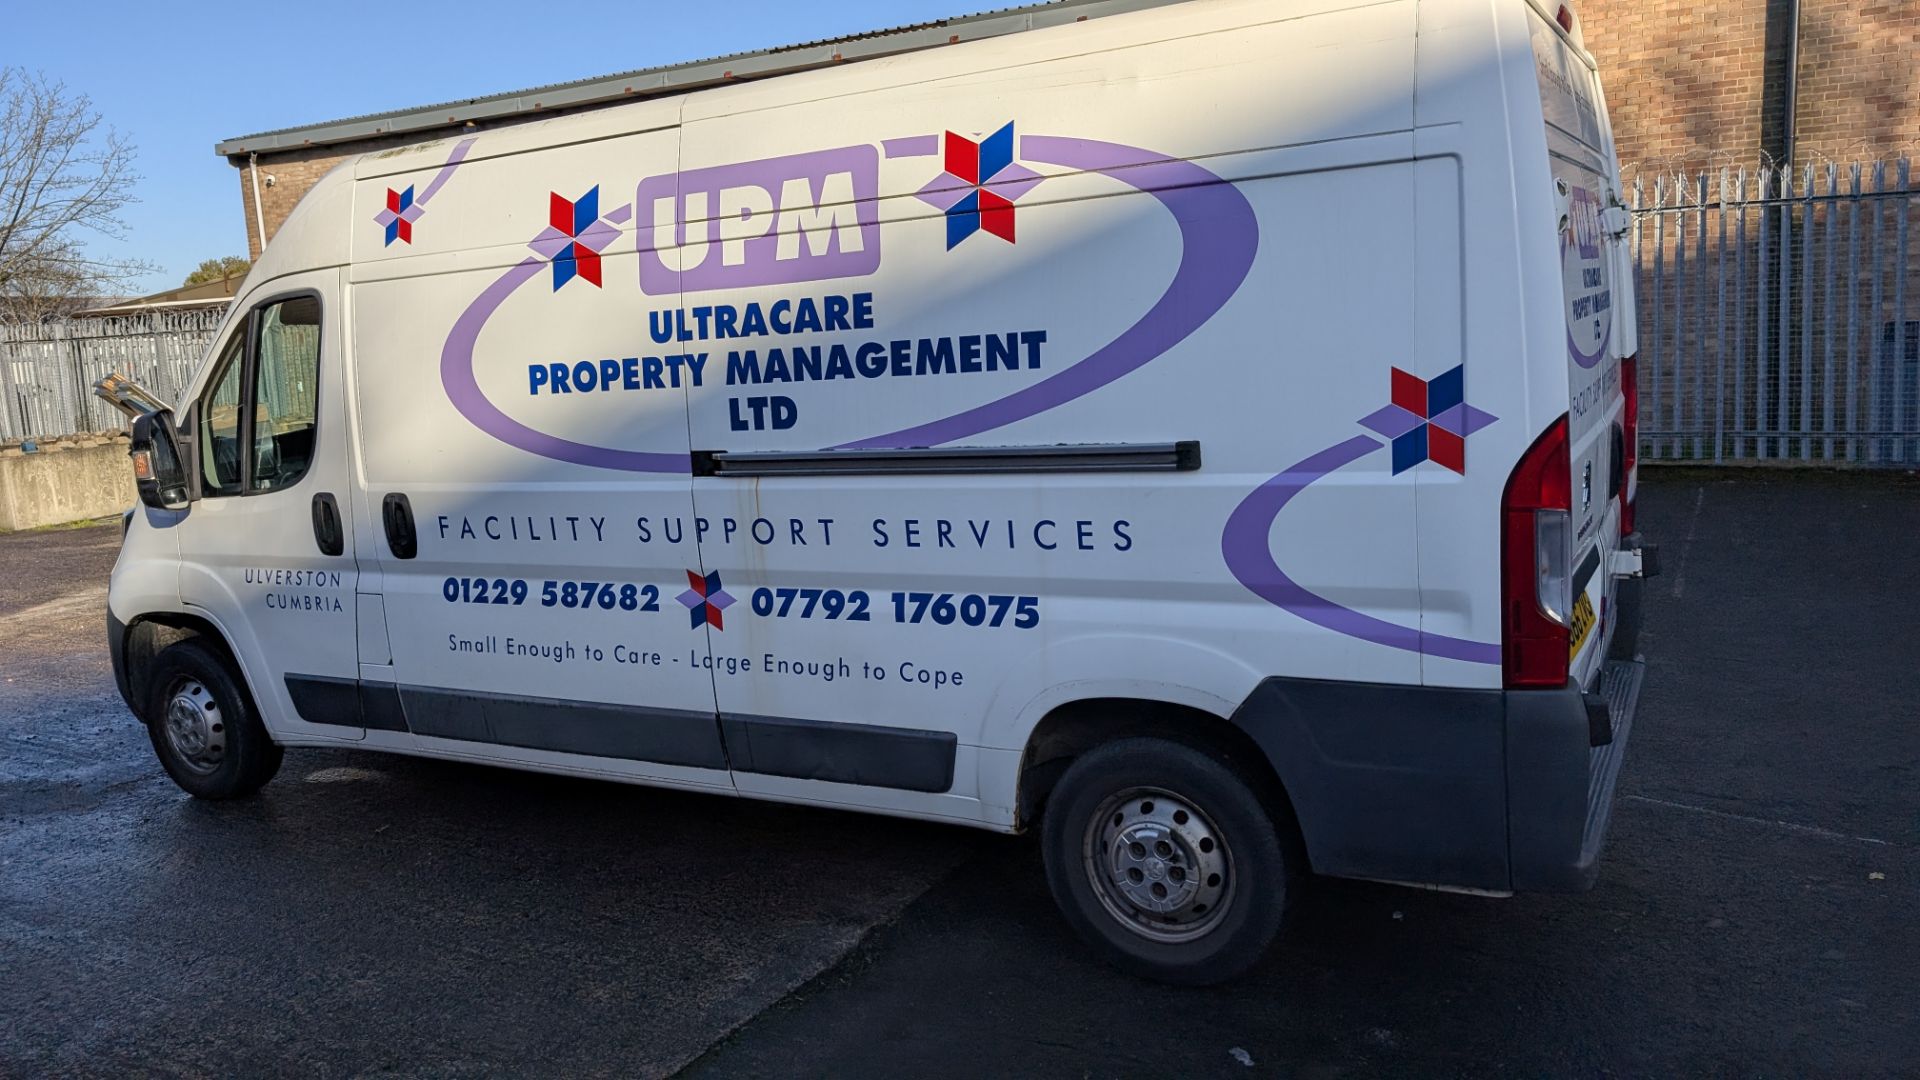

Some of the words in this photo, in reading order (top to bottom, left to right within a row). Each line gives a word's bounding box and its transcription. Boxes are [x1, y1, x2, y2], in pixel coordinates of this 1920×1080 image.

[653, 171, 865, 272] UPM
[649, 292, 874, 344] ULTRACARE
[528, 353, 709, 395] PROPERTY
[726, 330, 1047, 385] MANAGEMENT
[728, 395, 798, 432] LTD
[438, 515, 606, 542] FACILITY
[637, 516, 834, 546] SUPPORT
[872, 518, 1133, 552] SERVICES
[245, 569, 341, 588] ULVERSTON
[443, 577, 528, 606] 01229
[541, 580, 660, 612] 587682
[266, 593, 343, 613] CUMBRIA
[751, 587, 871, 622] 07792
[890, 592, 1040, 629] 176075
[449, 634, 496, 653] Small
[506, 637, 576, 662] Enough
[585, 644, 604, 662] to
[614, 644, 661, 667] Care
[690, 649, 751, 675] Large
[764, 653, 850, 682] Enough
[863, 662, 886, 681] to
[899, 661, 964, 690] Cope
